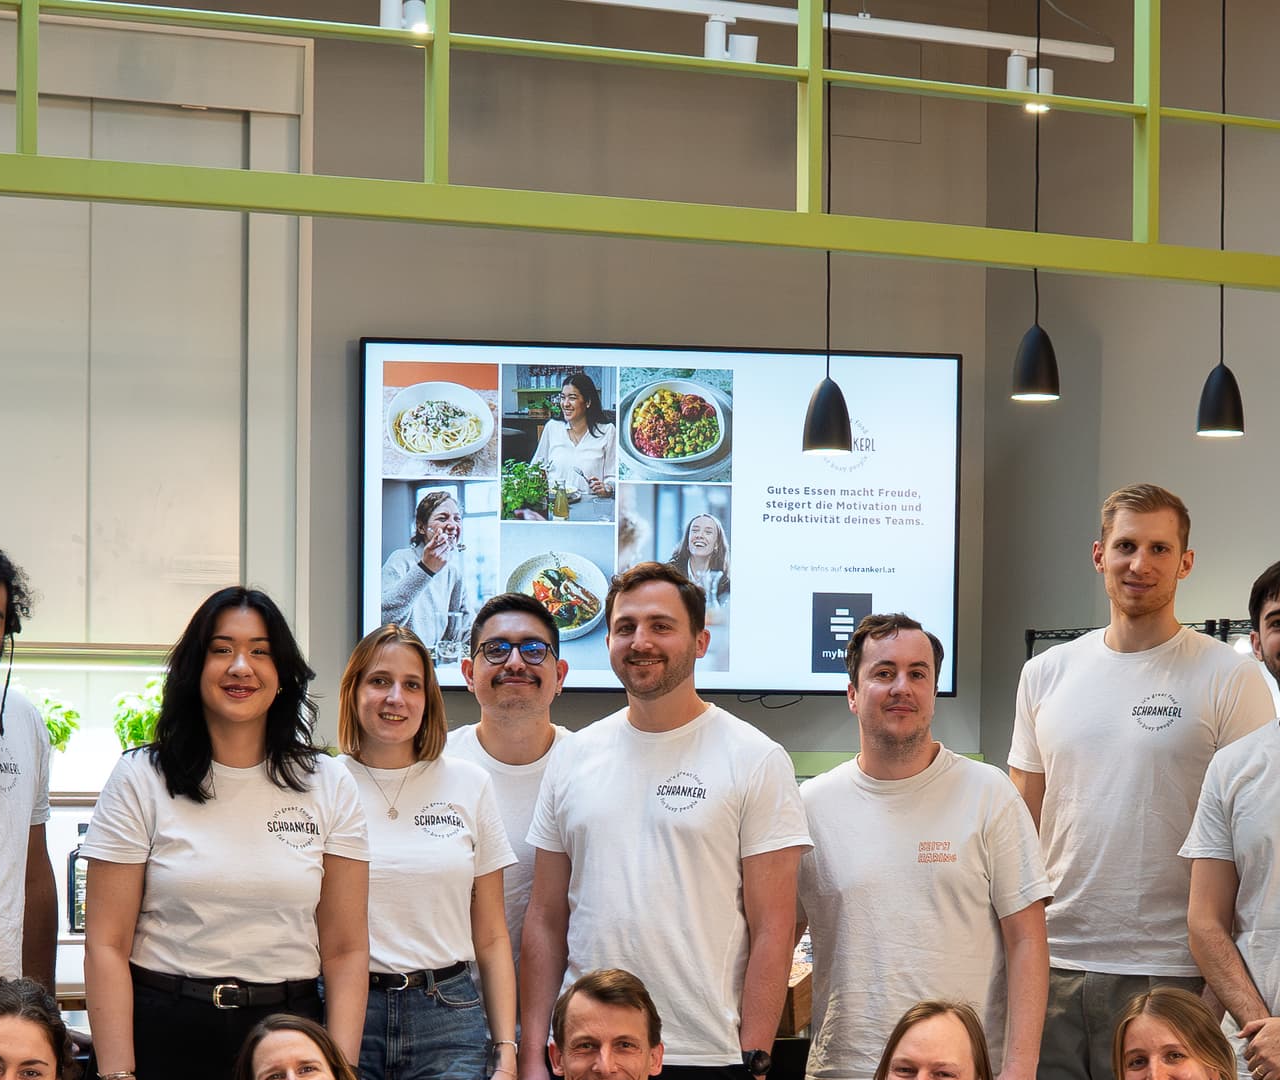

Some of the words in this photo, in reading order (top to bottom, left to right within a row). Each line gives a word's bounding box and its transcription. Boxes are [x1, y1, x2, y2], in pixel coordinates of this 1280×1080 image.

[767, 486, 800, 495] Gutes
[804, 487, 836, 496] Essen
[840, 488, 874, 497] macht
[878, 489, 921, 499] Freude,
[766, 500, 812, 511] steigert
[816, 500, 832, 510] die
[837, 501, 897, 511] Motivation
[901, 503, 922, 512] und
[763, 514, 840, 524] Produktivität
[844, 515, 881, 525] deines
[885, 516, 924, 526] Teams.
[845, 566, 895, 574] schrankerl.at
[822, 649, 848, 660] myhi
[1132, 705, 1182, 718] SCHRANKERL
[657, 785, 706, 799] SCHRANKERL
[267, 821, 320, 835] SCHRANKERL
[414, 815, 464, 828] SCHRANKERL
